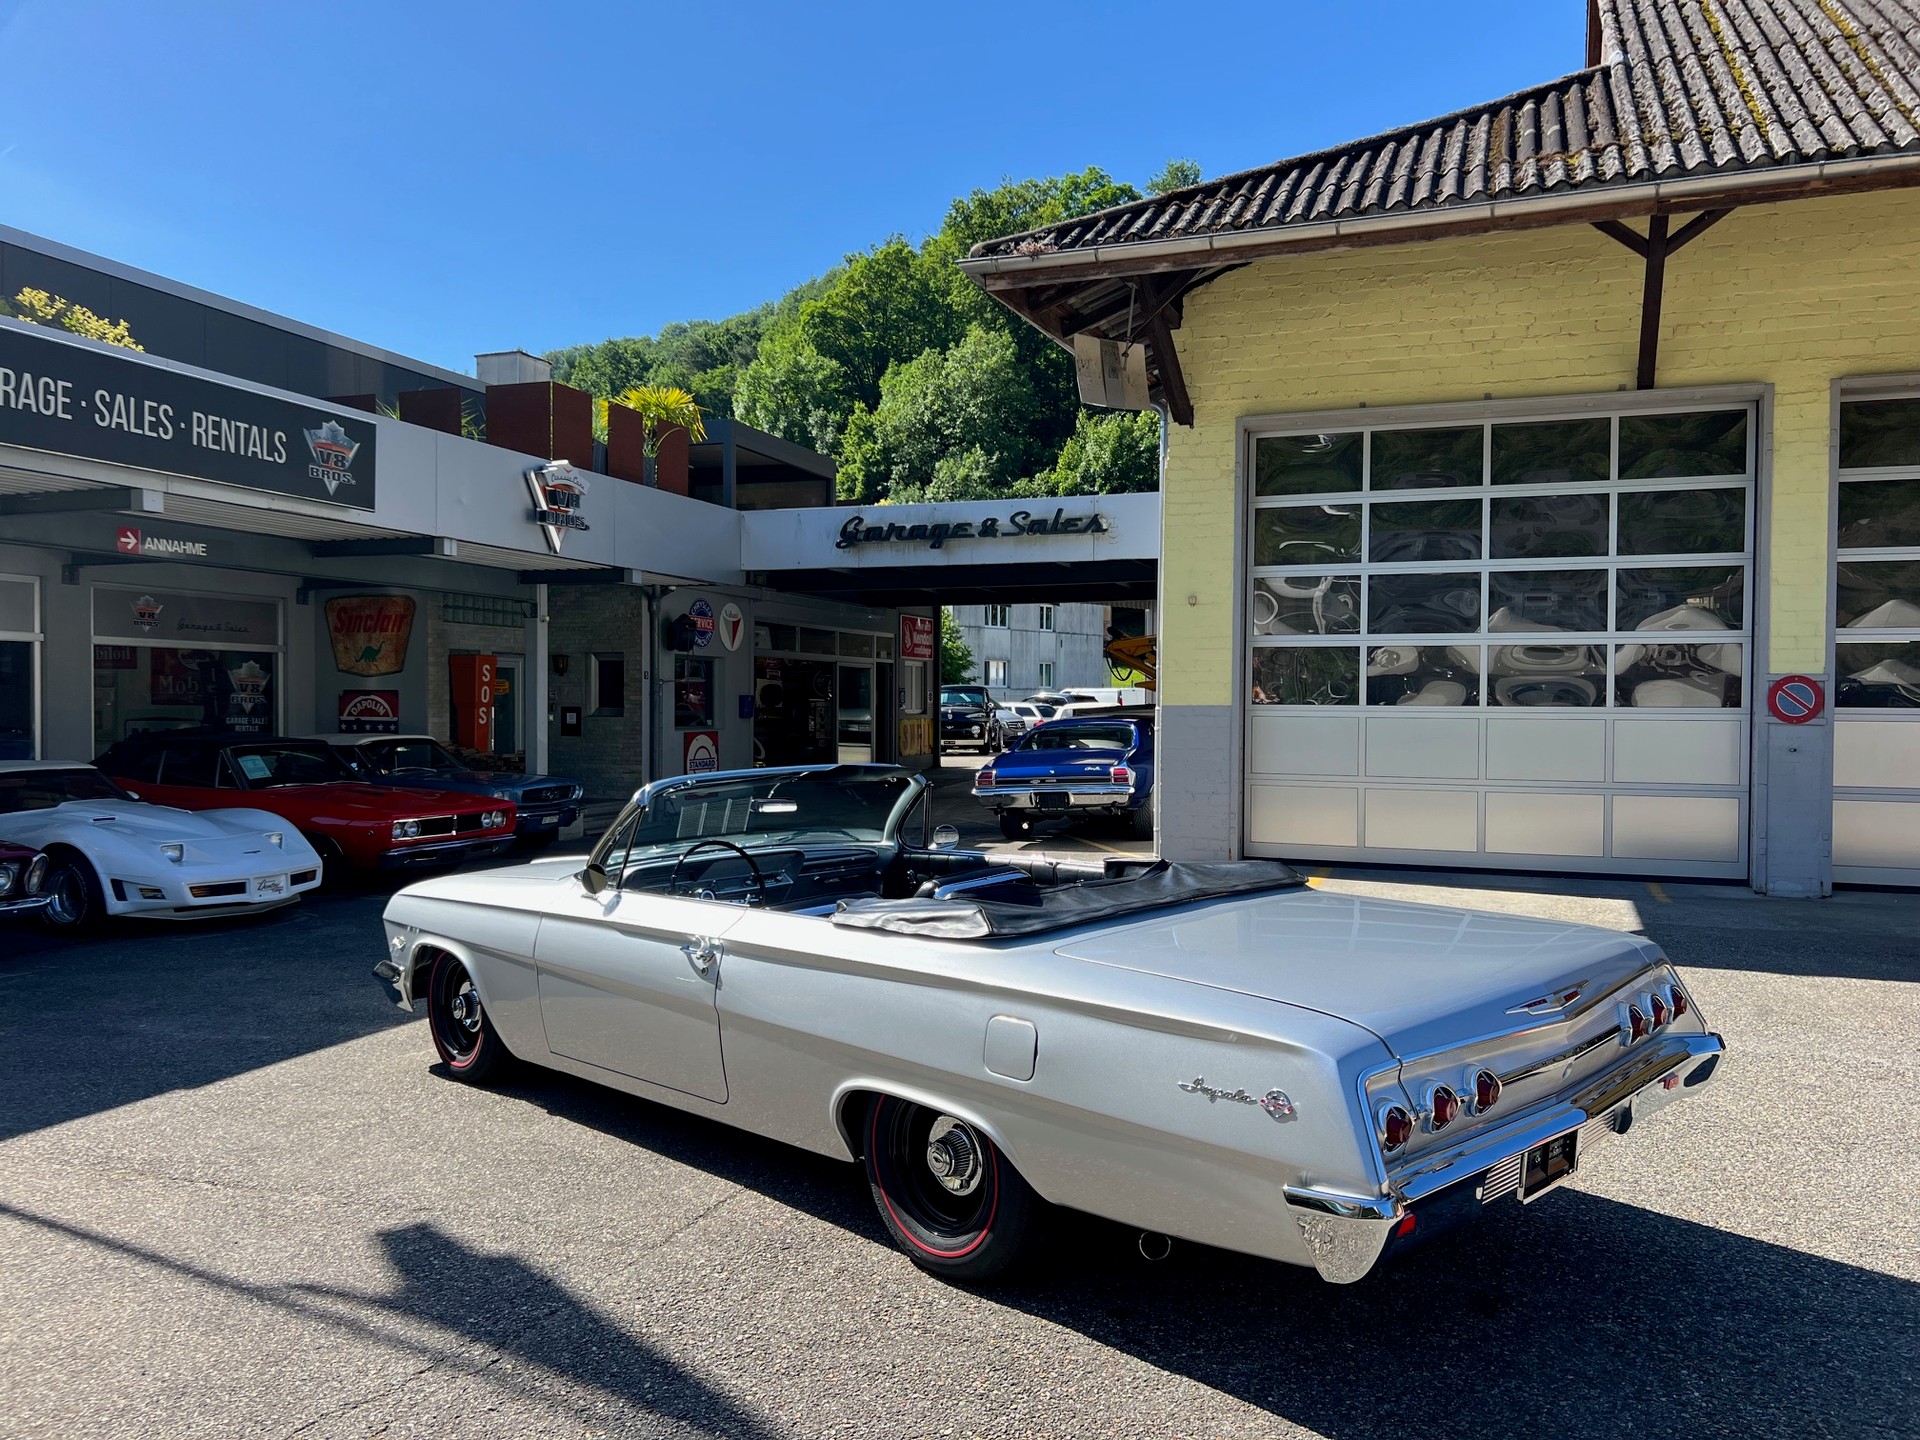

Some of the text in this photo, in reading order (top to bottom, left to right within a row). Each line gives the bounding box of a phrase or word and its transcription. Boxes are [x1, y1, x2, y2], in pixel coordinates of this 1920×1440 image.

[0, 367, 287, 464] RAGE SALES RENTALS
[317, 448, 347, 470] V8
[835, 507, 1109, 549] Garage & Sales
[144, 537, 208, 556] ANNAHME
[334, 605, 409, 634] Sinclair
[238, 682, 261, 693] V8
[478, 664, 491, 725] SOS
[350, 699, 387, 716] DAPOLIN
[689, 759, 716, 769] STANDARD
